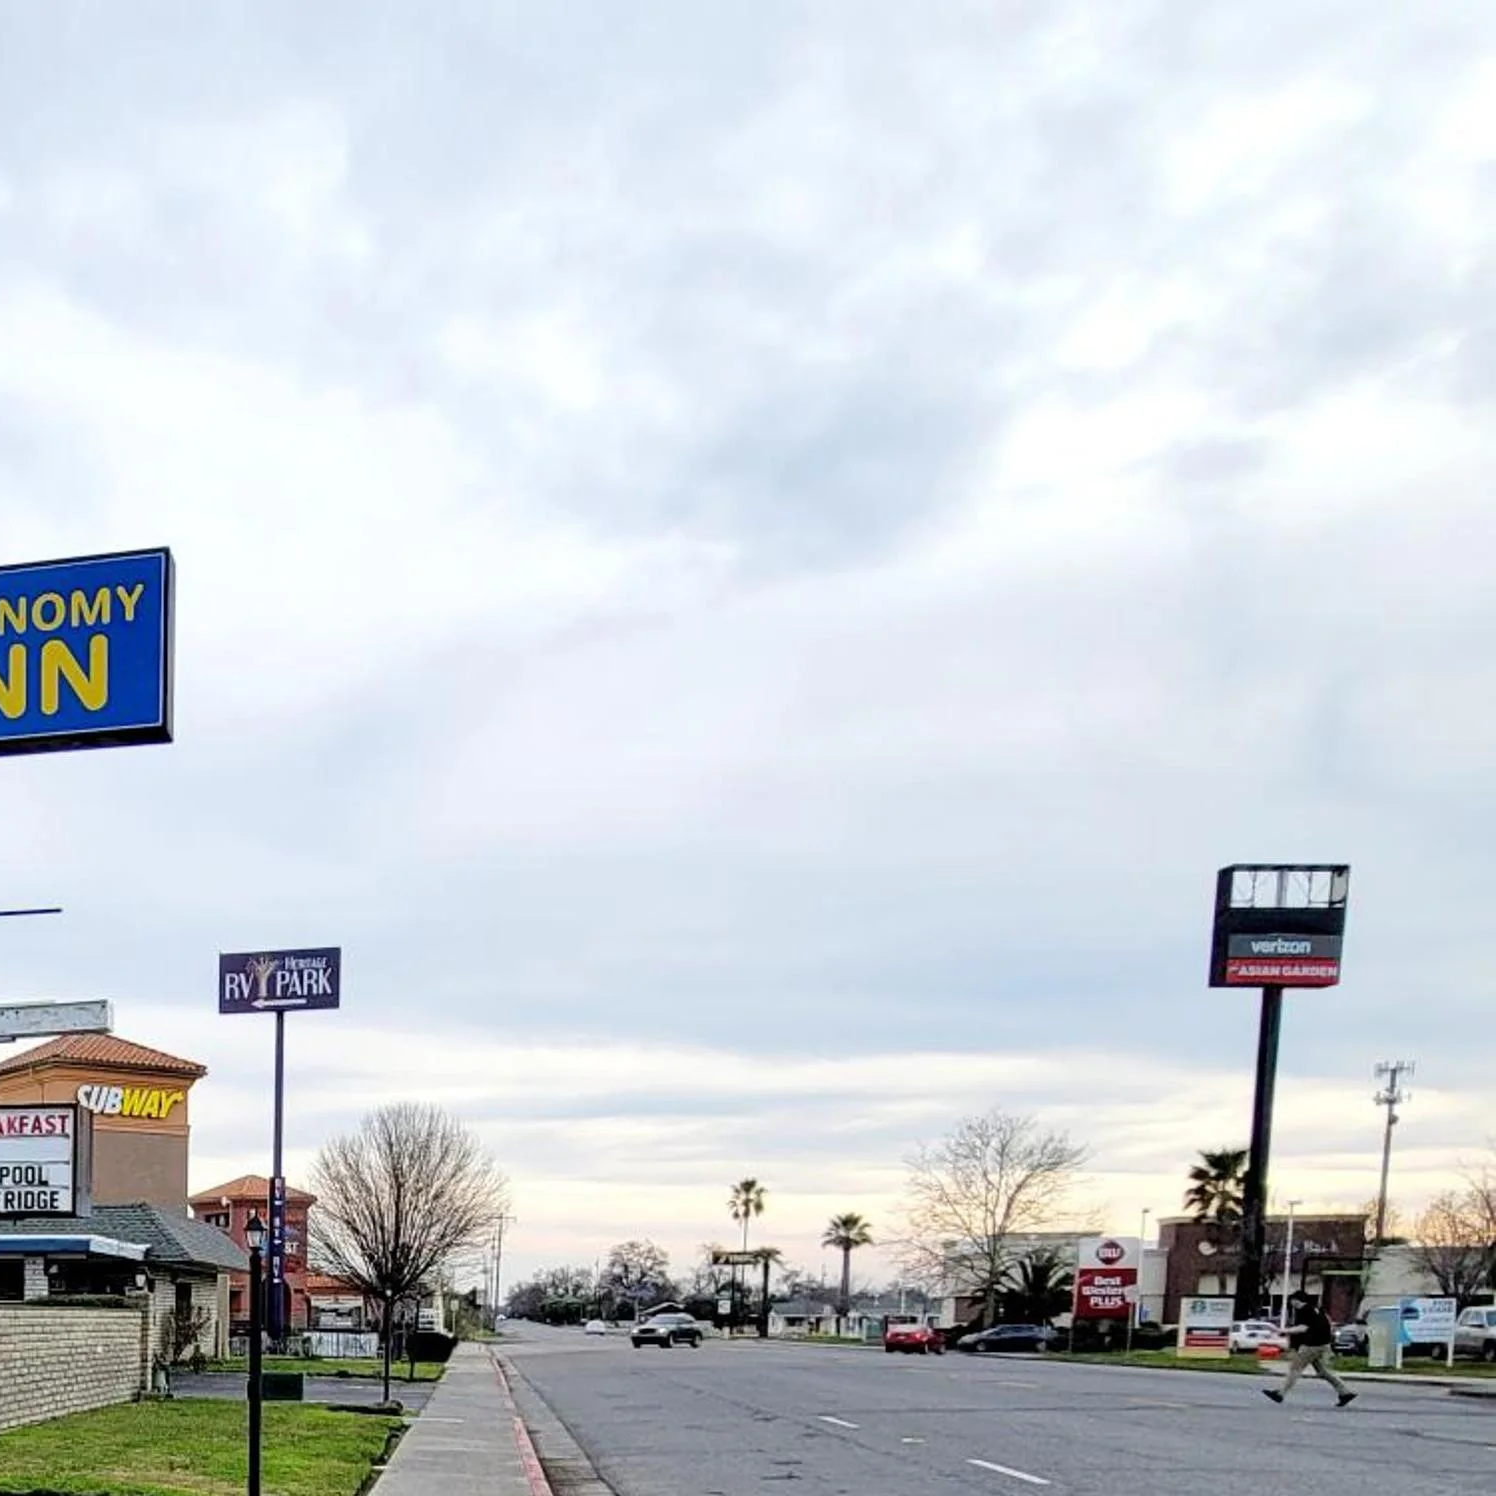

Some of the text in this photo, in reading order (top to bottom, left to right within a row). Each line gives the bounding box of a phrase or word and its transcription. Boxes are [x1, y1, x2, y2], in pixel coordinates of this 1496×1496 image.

[1250, 938, 1312, 954] verizon
[225, 967, 333, 1000] RV PARK
[77, 1085, 184, 1119] SUBWAY
[0, 1166, 49, 1186] POOL
